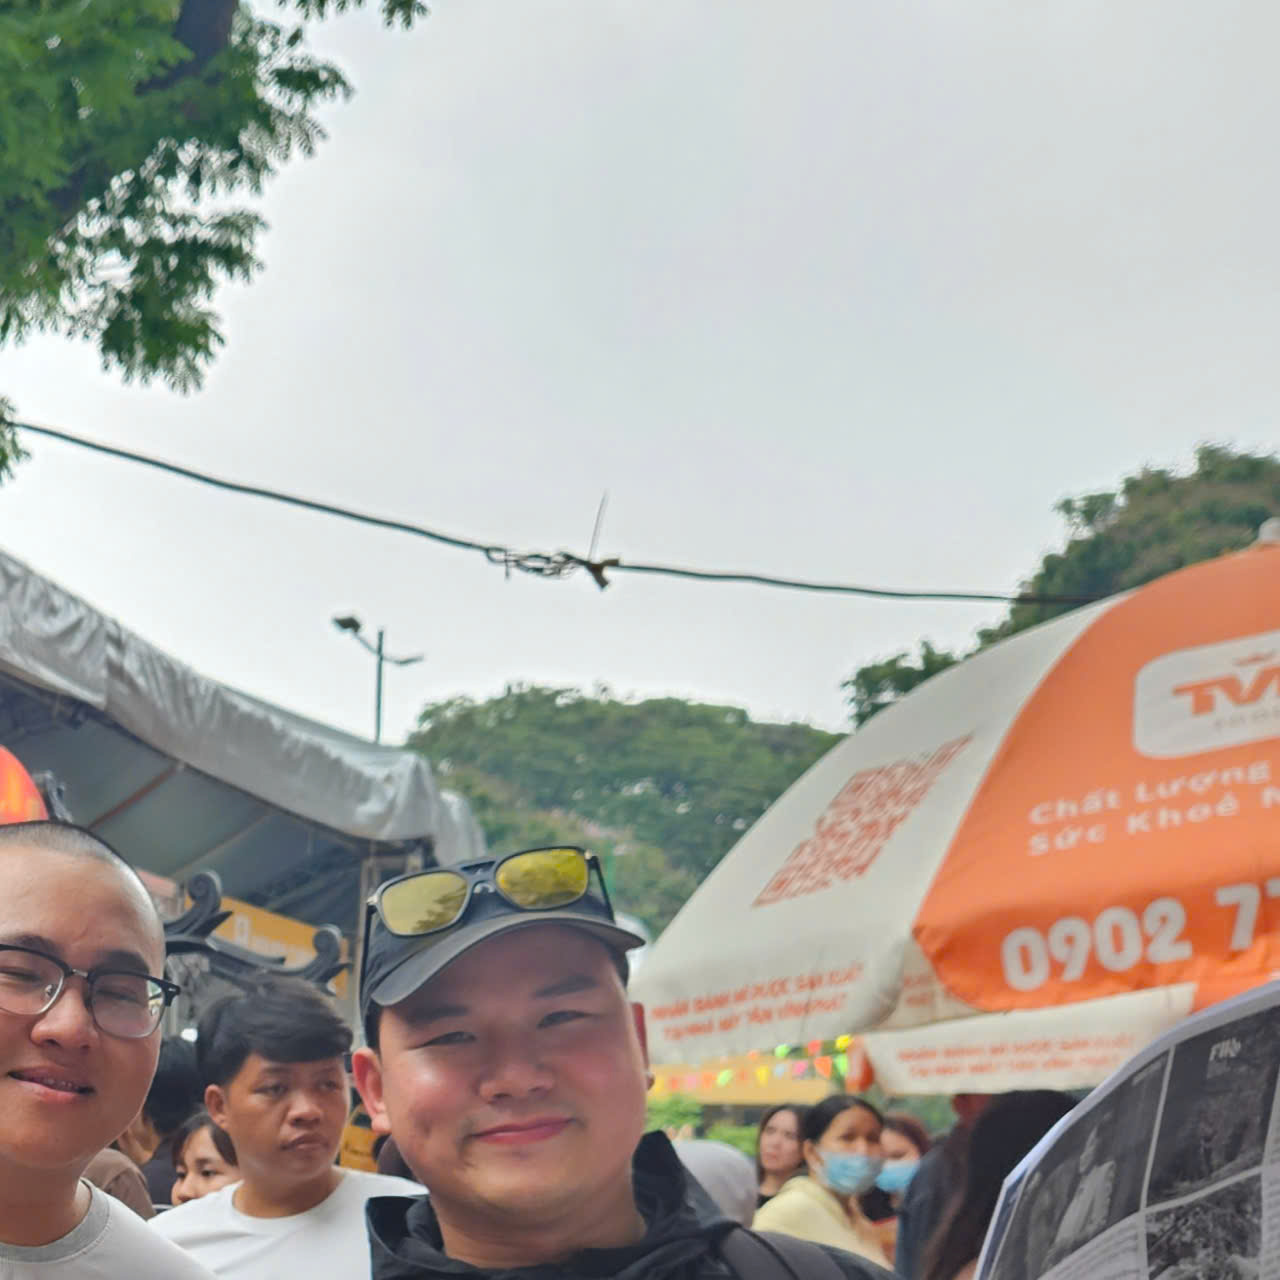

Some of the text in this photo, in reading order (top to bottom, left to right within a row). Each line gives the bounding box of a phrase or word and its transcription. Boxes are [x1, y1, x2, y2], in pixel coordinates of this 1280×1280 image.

[1028, 788, 1122, 825] Chất
[1001, 896, 1194, 993] 0902
[1215, 875, 1280, 951] 7
